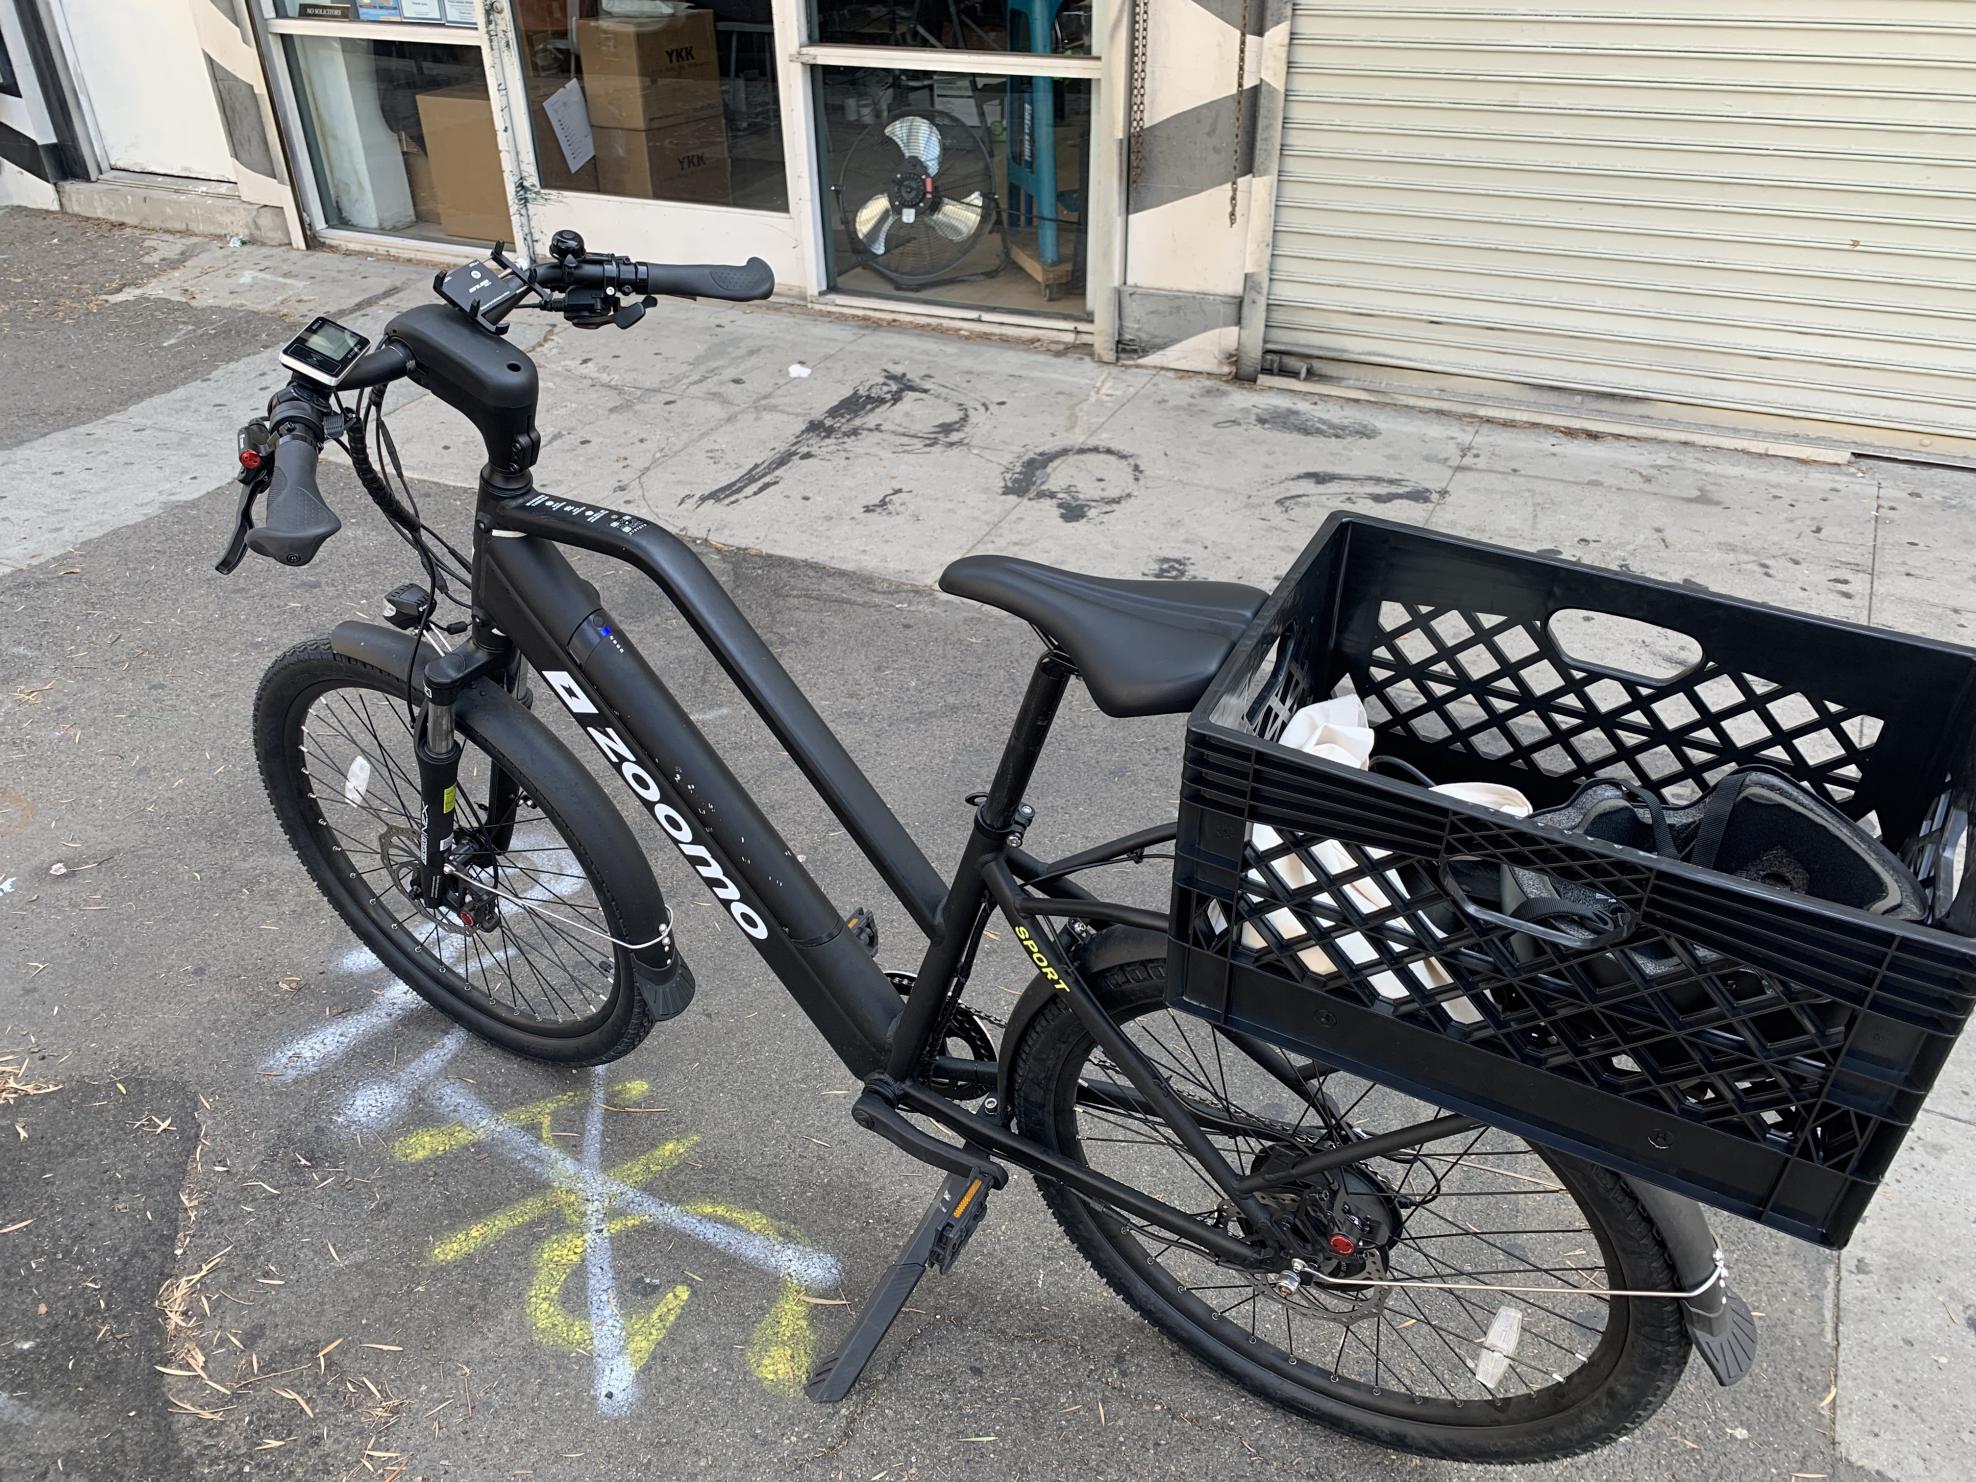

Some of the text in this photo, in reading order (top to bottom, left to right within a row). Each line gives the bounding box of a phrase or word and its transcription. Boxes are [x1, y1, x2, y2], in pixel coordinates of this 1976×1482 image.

[314, 8, 342, 16] SOLICITORS
[664, 46, 695, 65] YKK
[677, 152, 706, 171] YKK
[587, 726, 768, 940] zoomo
[1015, 926, 1071, 993] SPORT
